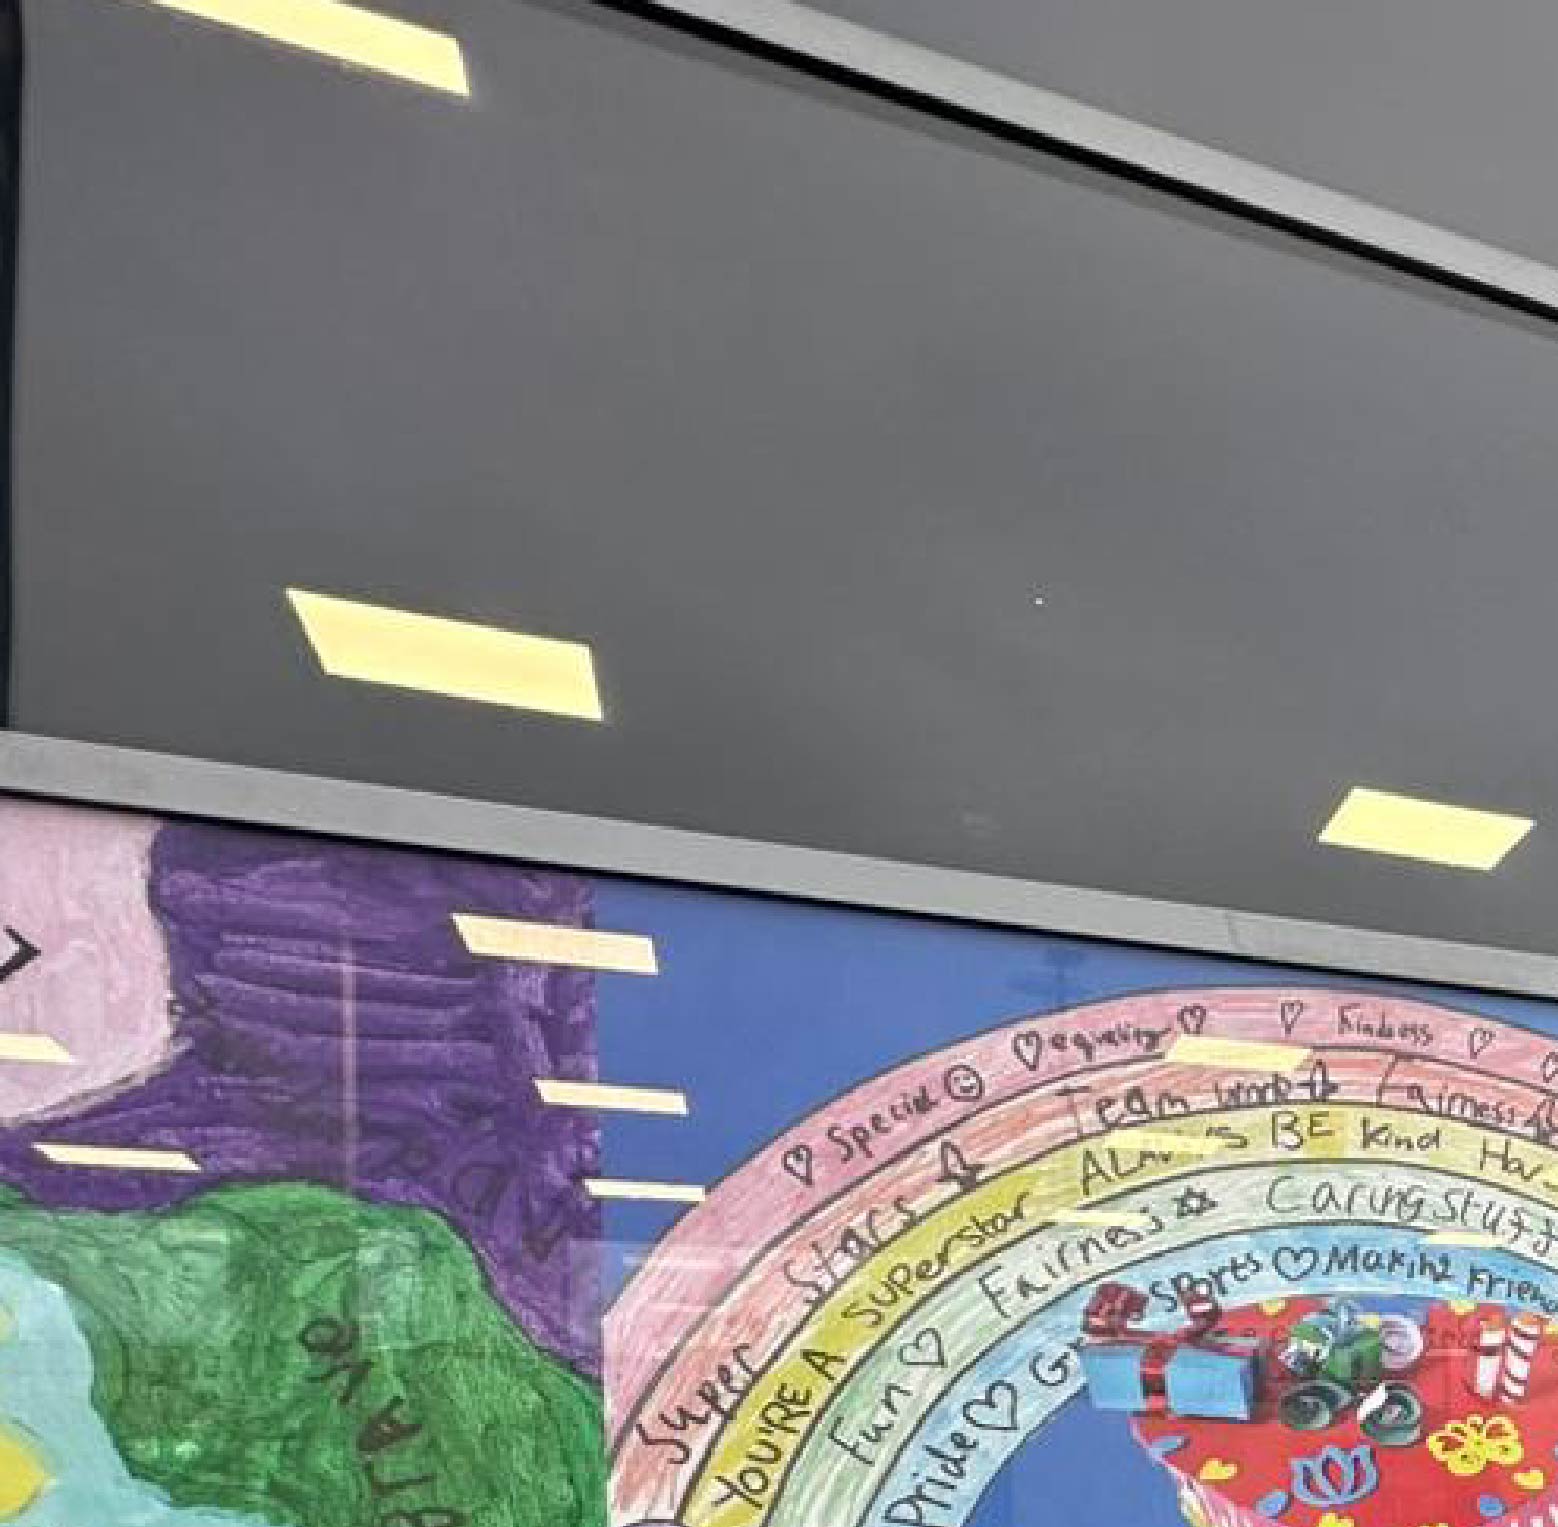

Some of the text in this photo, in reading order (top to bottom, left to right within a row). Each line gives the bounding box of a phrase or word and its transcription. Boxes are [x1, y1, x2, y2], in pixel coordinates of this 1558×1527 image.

[1271, 1110, 1333, 1151] BE
[806, 1348, 848, 1382] A
[828, 1382, 914, 1466] Fun
